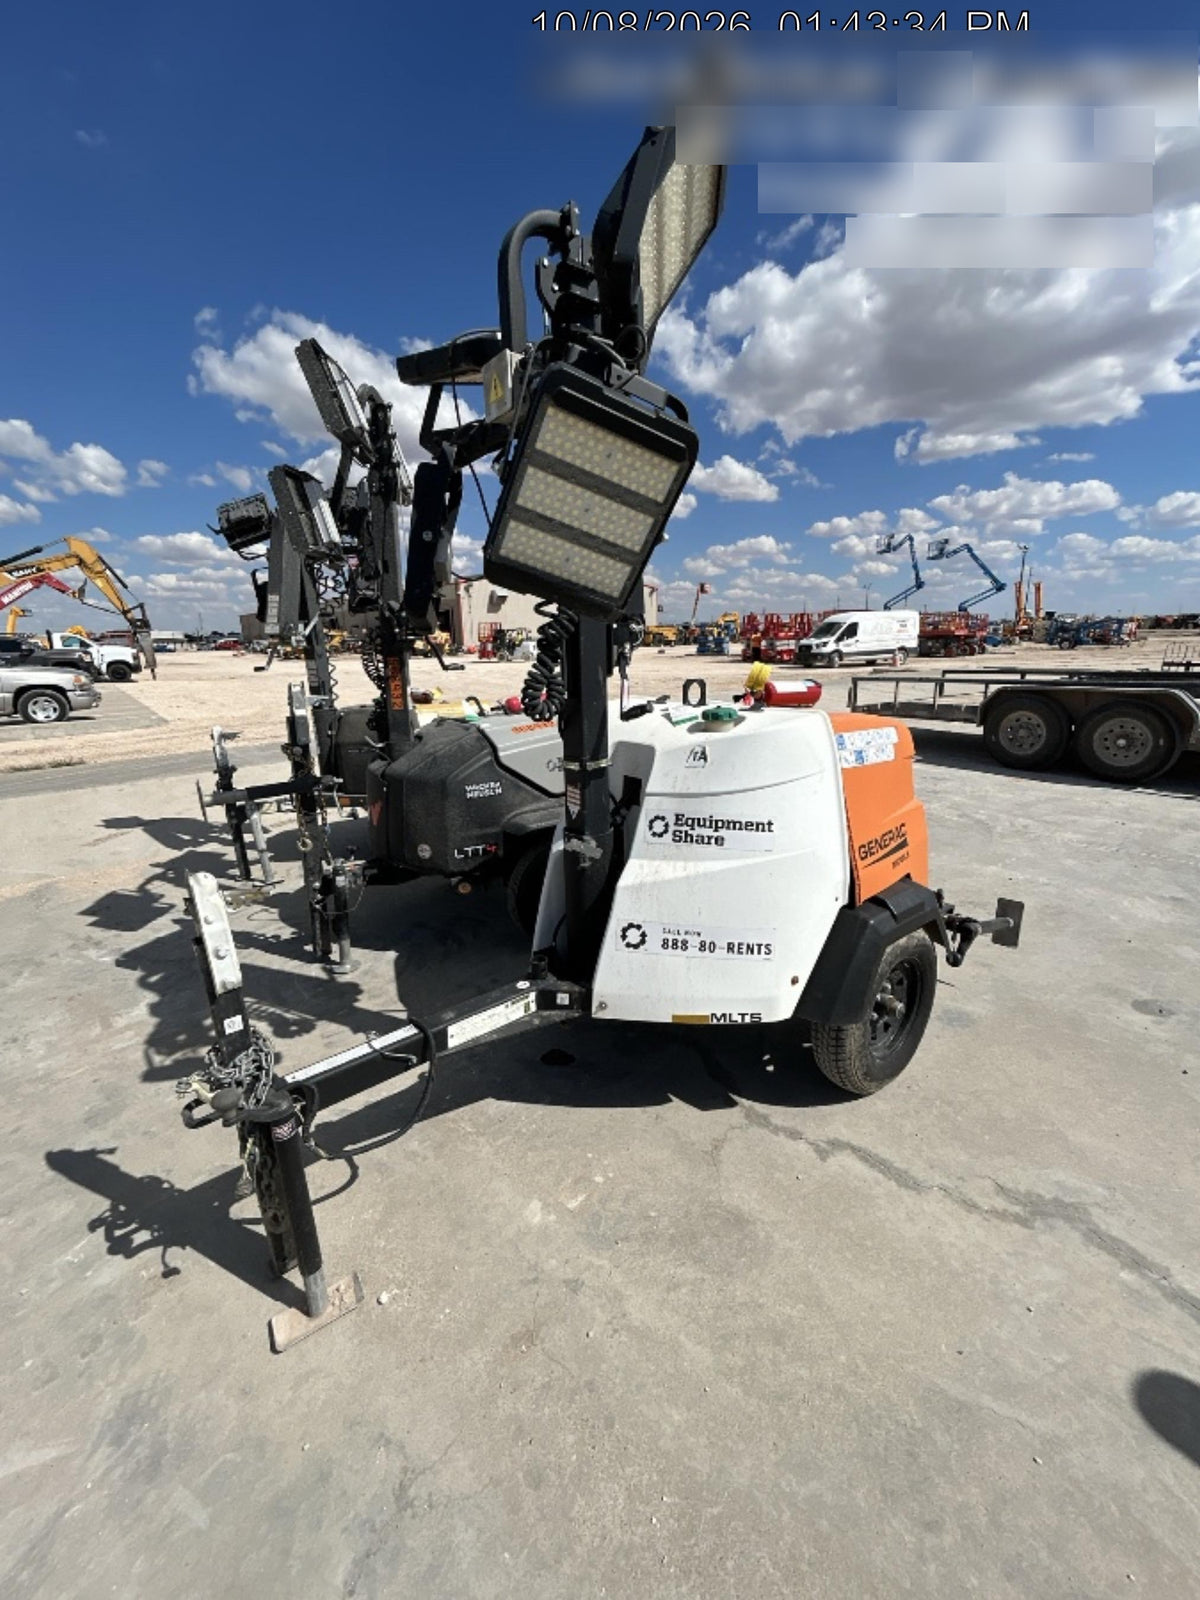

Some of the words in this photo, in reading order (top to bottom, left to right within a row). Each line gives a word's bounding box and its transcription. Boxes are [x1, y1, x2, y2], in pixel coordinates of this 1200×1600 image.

[673, 813, 774, 833] Equipment
[672, 830, 725, 847] Share
[661, 938, 773, 956] 888-80-RENTS
